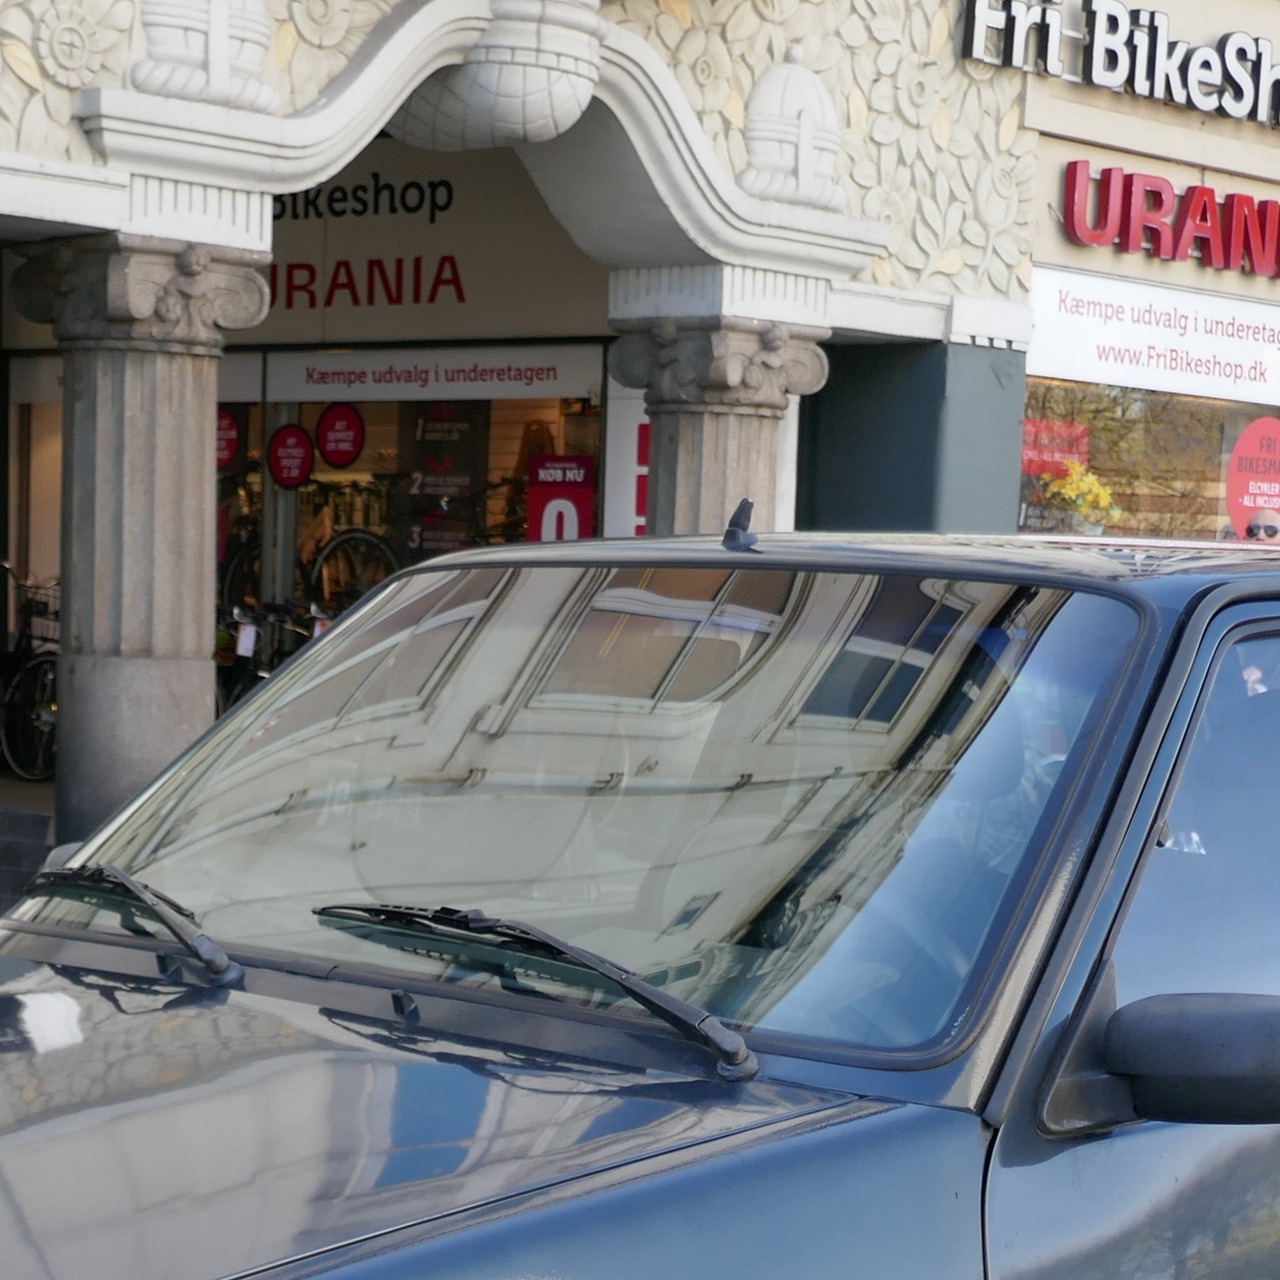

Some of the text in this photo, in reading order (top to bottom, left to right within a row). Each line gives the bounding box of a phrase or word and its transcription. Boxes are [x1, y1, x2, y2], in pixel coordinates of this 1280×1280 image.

[968, 0, 1063, 77] Fri
[1058, 290, 1124, 325] Kæmpe
[1130, 304, 1189, 337] udvalg
[1194, 311, 1199, 332] i
[305, 363, 558, 388] Kæmpe udvalg i underetagen
[1096, 344, 1268, 385] www.FriBikeshop.dk
[1260, 437, 1277, 454] FRI
